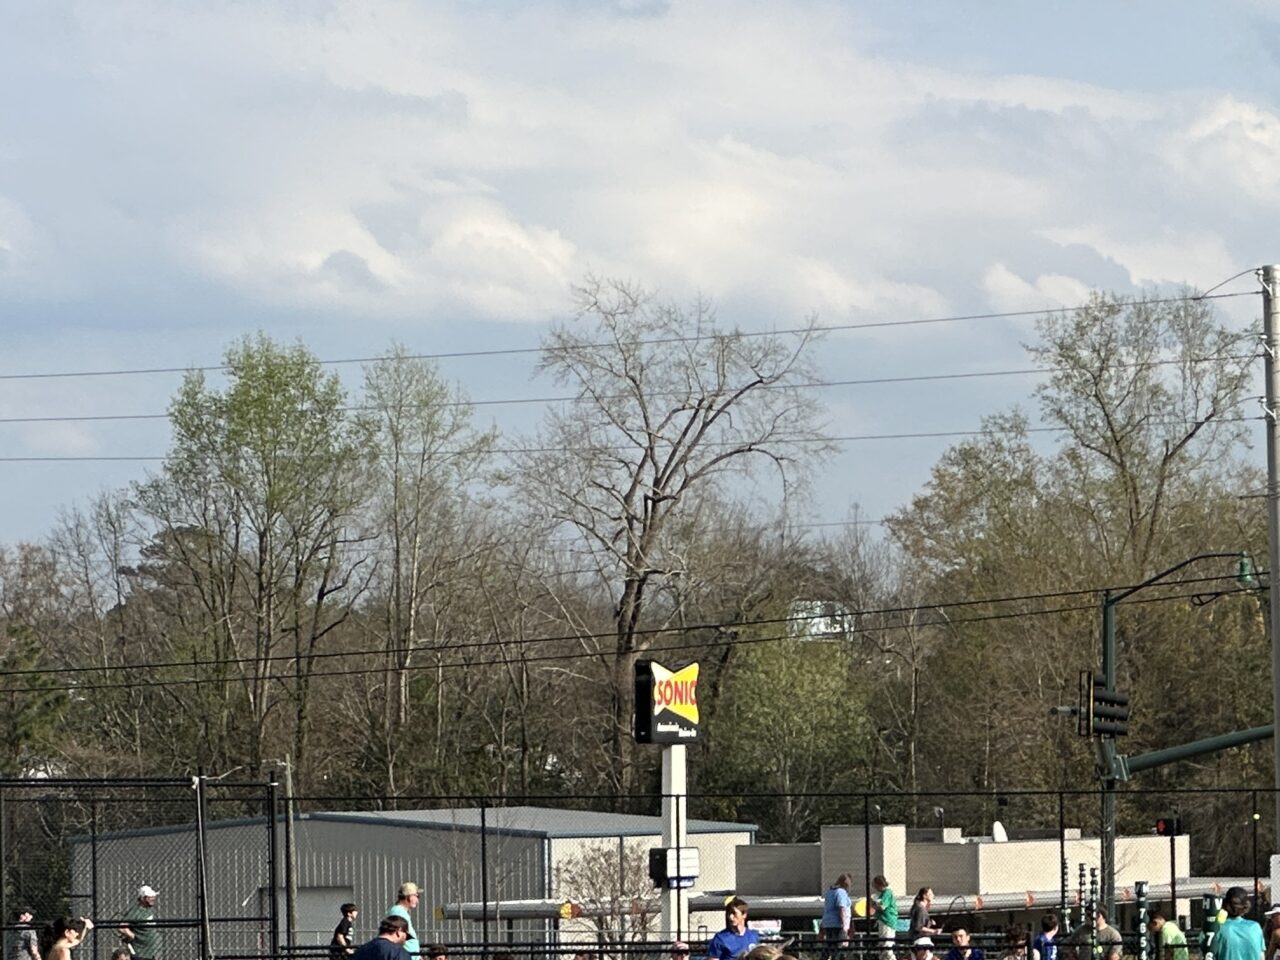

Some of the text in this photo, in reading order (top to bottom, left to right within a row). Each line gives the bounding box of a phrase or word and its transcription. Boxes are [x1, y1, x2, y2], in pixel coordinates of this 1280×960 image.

[655, 680, 699, 706] SONIC
[1215, 898, 1223, 910] V
[1139, 908, 1146, 919] 7
[1206, 931, 1216, 947] 7
